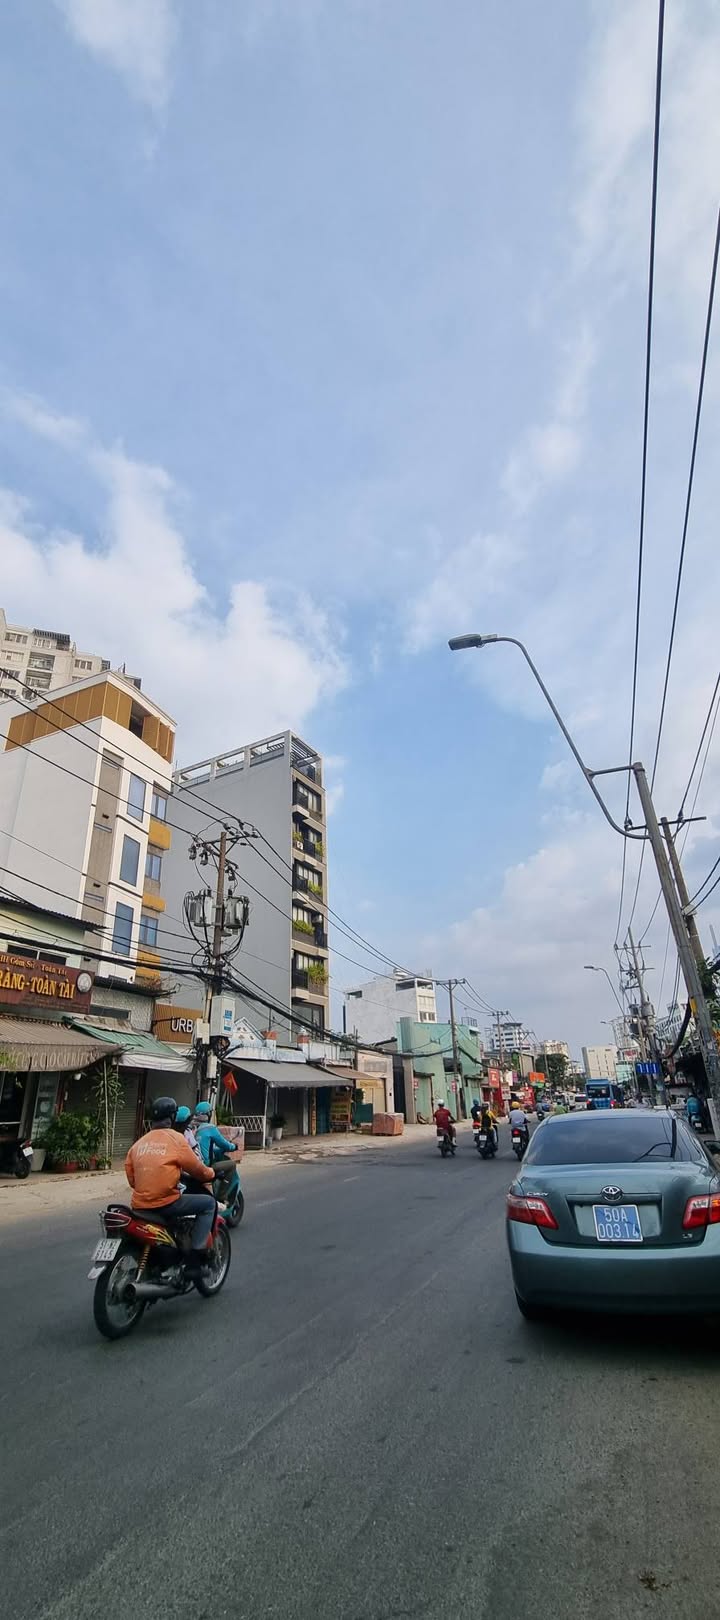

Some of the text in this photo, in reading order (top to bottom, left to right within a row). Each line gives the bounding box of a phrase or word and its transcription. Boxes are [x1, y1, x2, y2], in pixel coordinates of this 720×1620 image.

[58, 978, 76, 998] TÀI
[603, 1207, 628, 1222] 50A
[598, 1223, 640, 1238] 003.14
